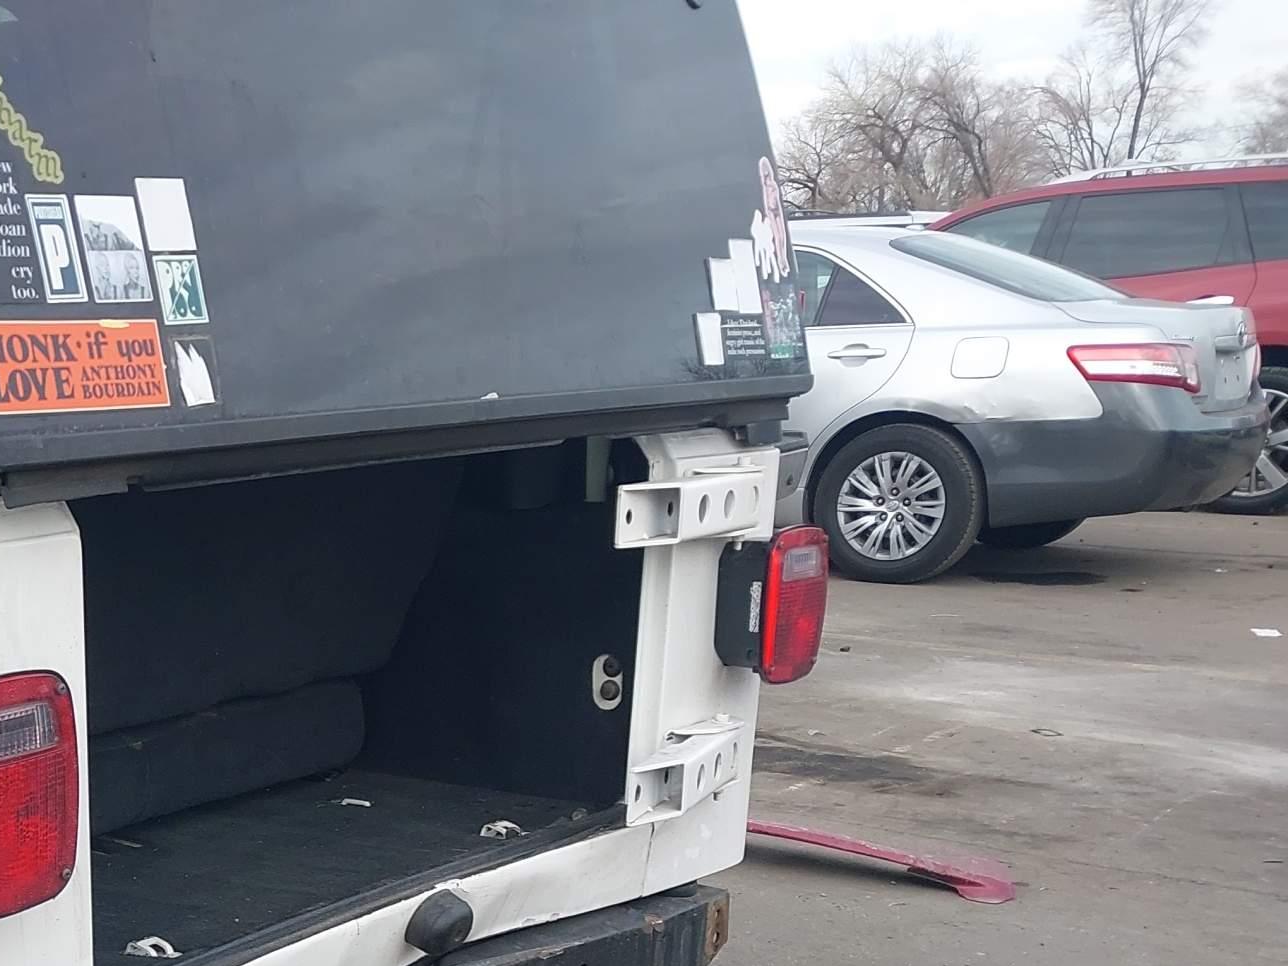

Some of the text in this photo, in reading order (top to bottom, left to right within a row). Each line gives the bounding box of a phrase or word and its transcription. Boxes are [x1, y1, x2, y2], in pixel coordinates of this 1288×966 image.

[11, 284, 39, 299] too.
[86, 331, 108, 360] if
[117, 339, 155, 362] you
[81, 364, 157, 382] ANTHONY
[82, 381, 162, 400] BOURDAIN
